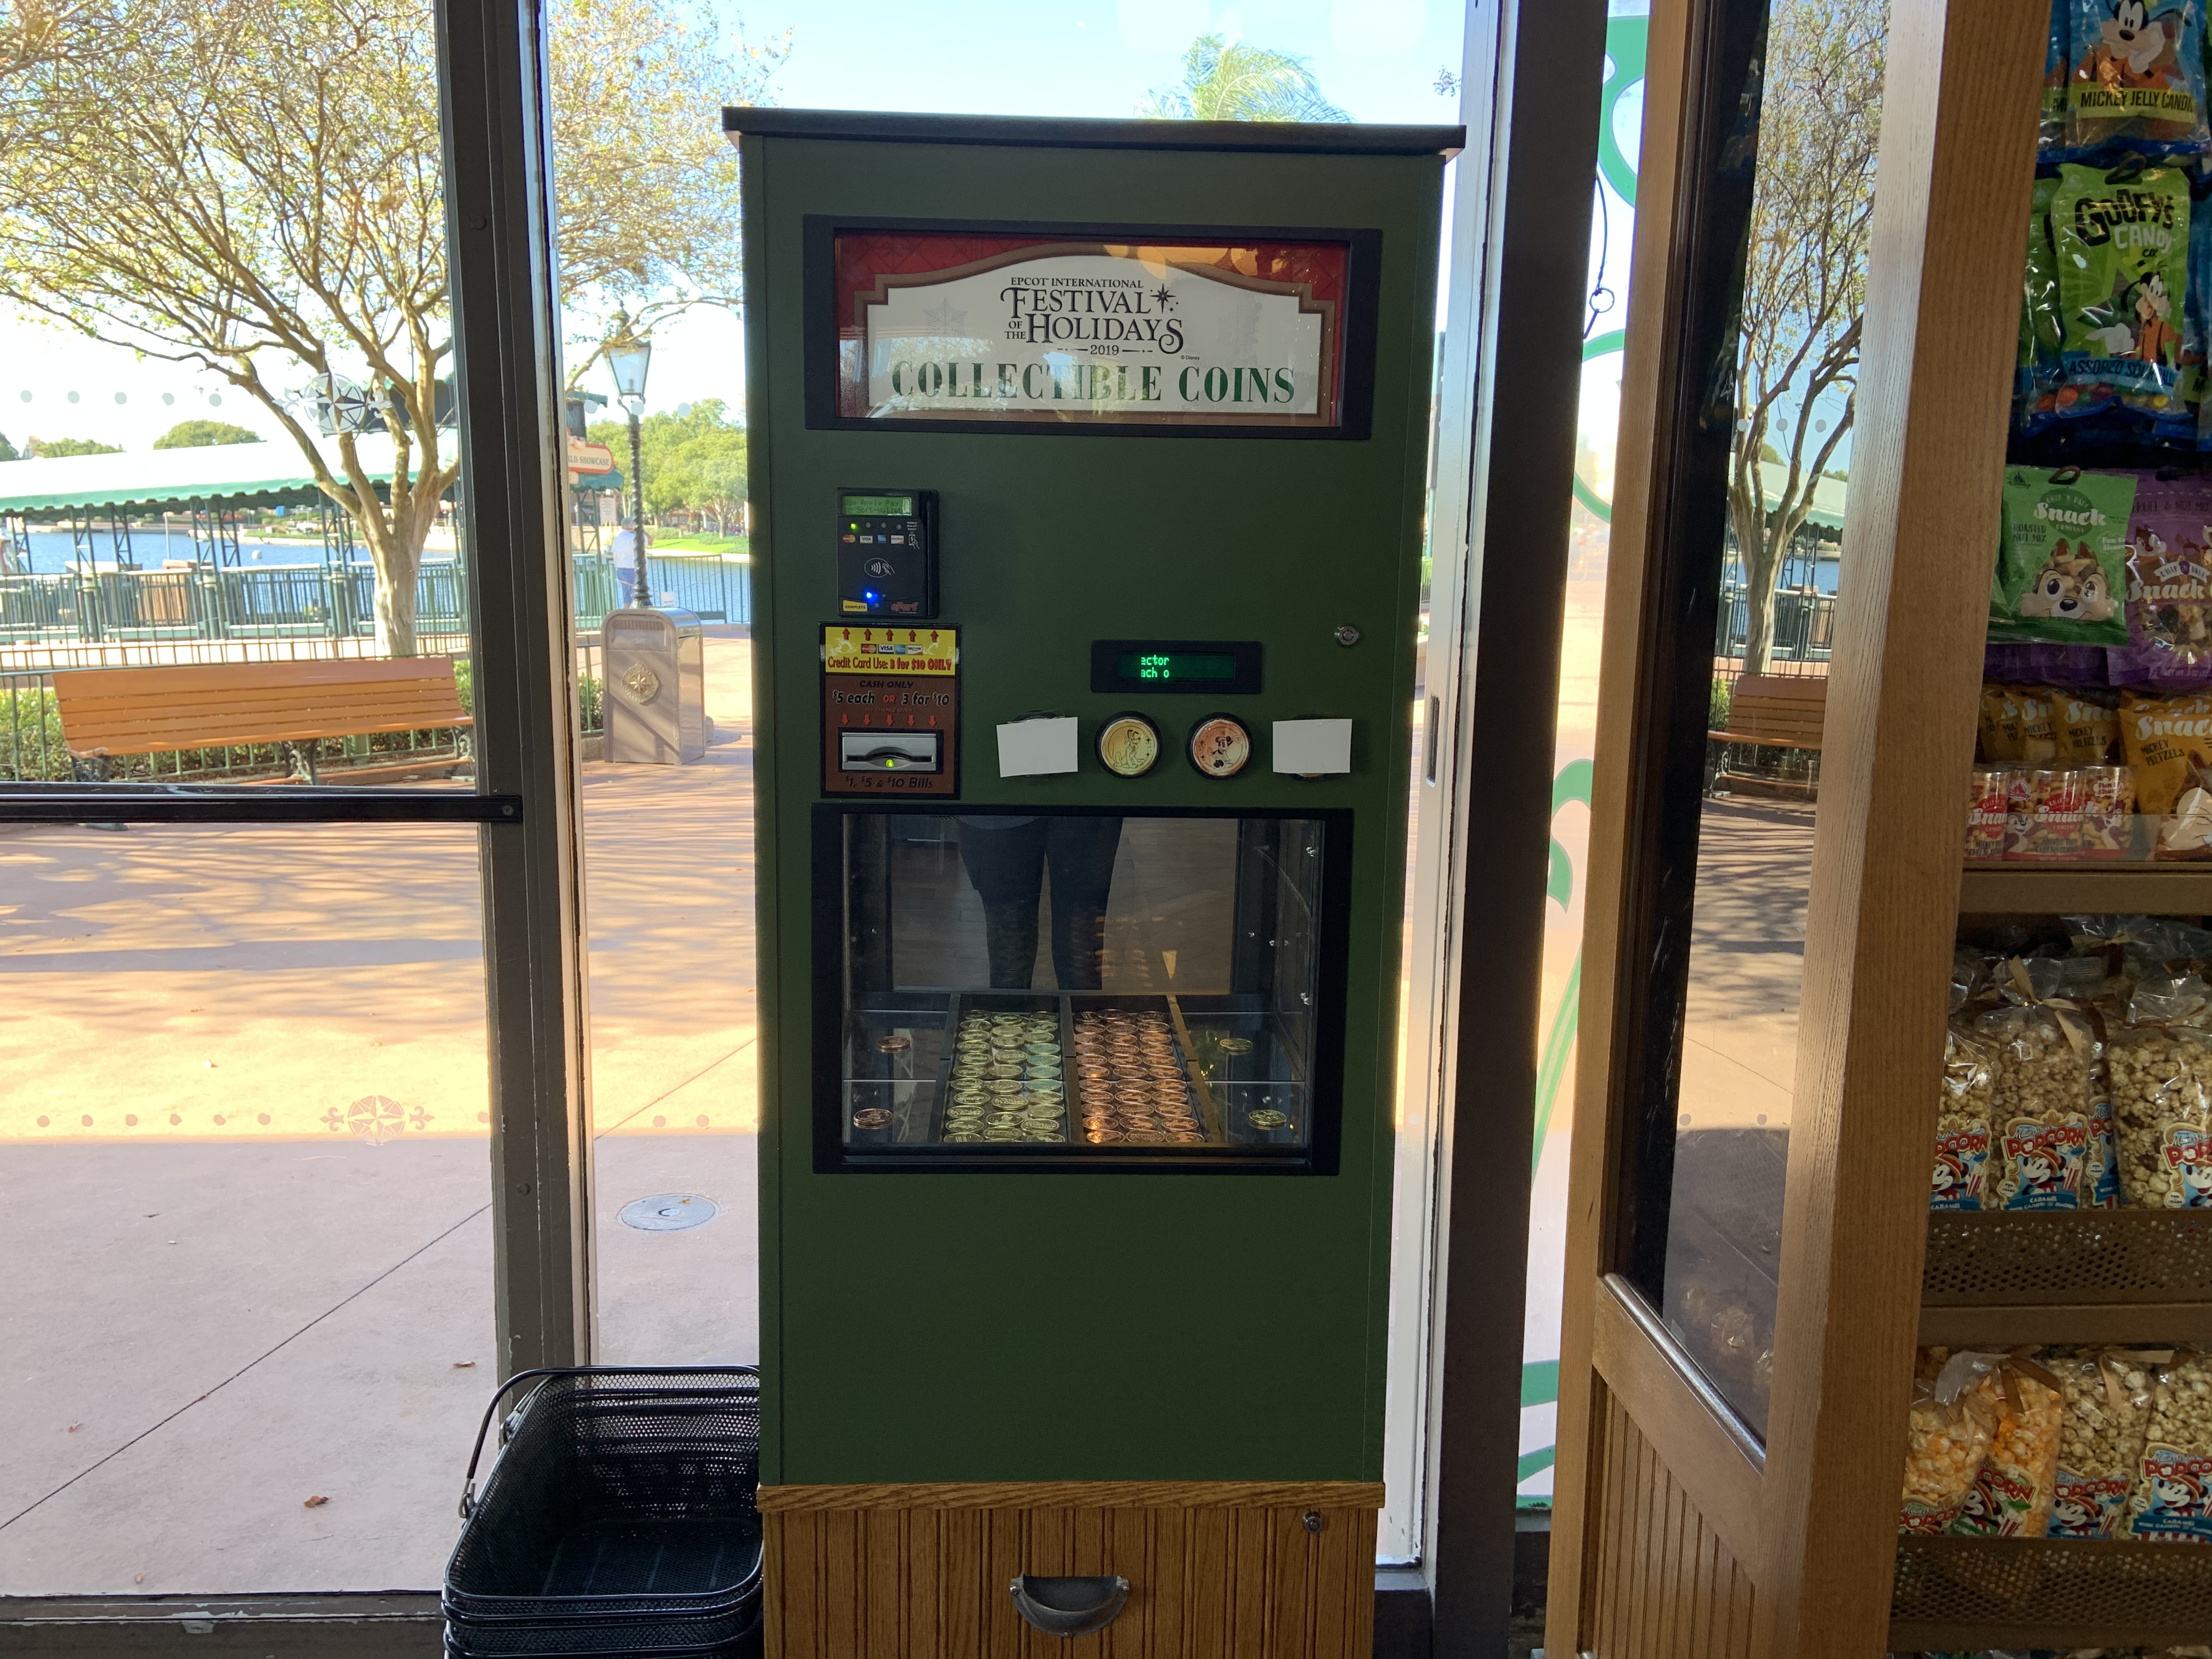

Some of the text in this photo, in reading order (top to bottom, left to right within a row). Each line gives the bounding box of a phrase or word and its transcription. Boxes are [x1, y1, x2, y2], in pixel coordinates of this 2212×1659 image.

[2130, 91, 2160, 106] JELLY
[1051, 278, 1144, 289] INTERNATIONAL
[1000, 287, 1151, 319] FESTIVAL
[1008, 321, 1023, 329] OF
[1005, 331, 1026, 340] THE
[1025, 313, 1183, 354] HOLIDAYS
[1090, 345, 1119, 355] 2019
[892, 361, 1295, 403] COLLECTIBLE COINS
[579, 456, 610, 466] SHOWCASE
[2033, 502, 2107, 526] Snack
[2013, 523, 2046, 533] ROASTED
[2013, 533, 2046, 542] NUT MIX
[2125, 578, 2205, 602] Snack
[827, 656, 851, 669] Credit
[853, 657, 871, 669] Card
[873, 658, 889, 669] Use:
[896, 658, 910, 670] for
[911, 658, 926, 670] $10
[928, 659, 952, 671] ONLY
[860, 680, 913, 689] CASH ONLY
[833, 690, 950, 706] $5 each OR 3 for $10
[2135, 716, 2212, 741] Snac
[2140, 738, 2169, 754] MICKEY
[2146, 748, 2185, 766] PRETZELS
[860, 775, 872, 787] $5
[886, 776, 904, 788] $10
[909, 777, 933, 788] Bills
[1936, 1129, 1955, 1139] treet
[2006, 1126, 2087, 1158] POPCORN
[1935, 1132, 1989, 1156] PCORN
[2143, 1459, 2212, 1479] POPCO
[2055, 1479, 2129, 1499] OPCORN
